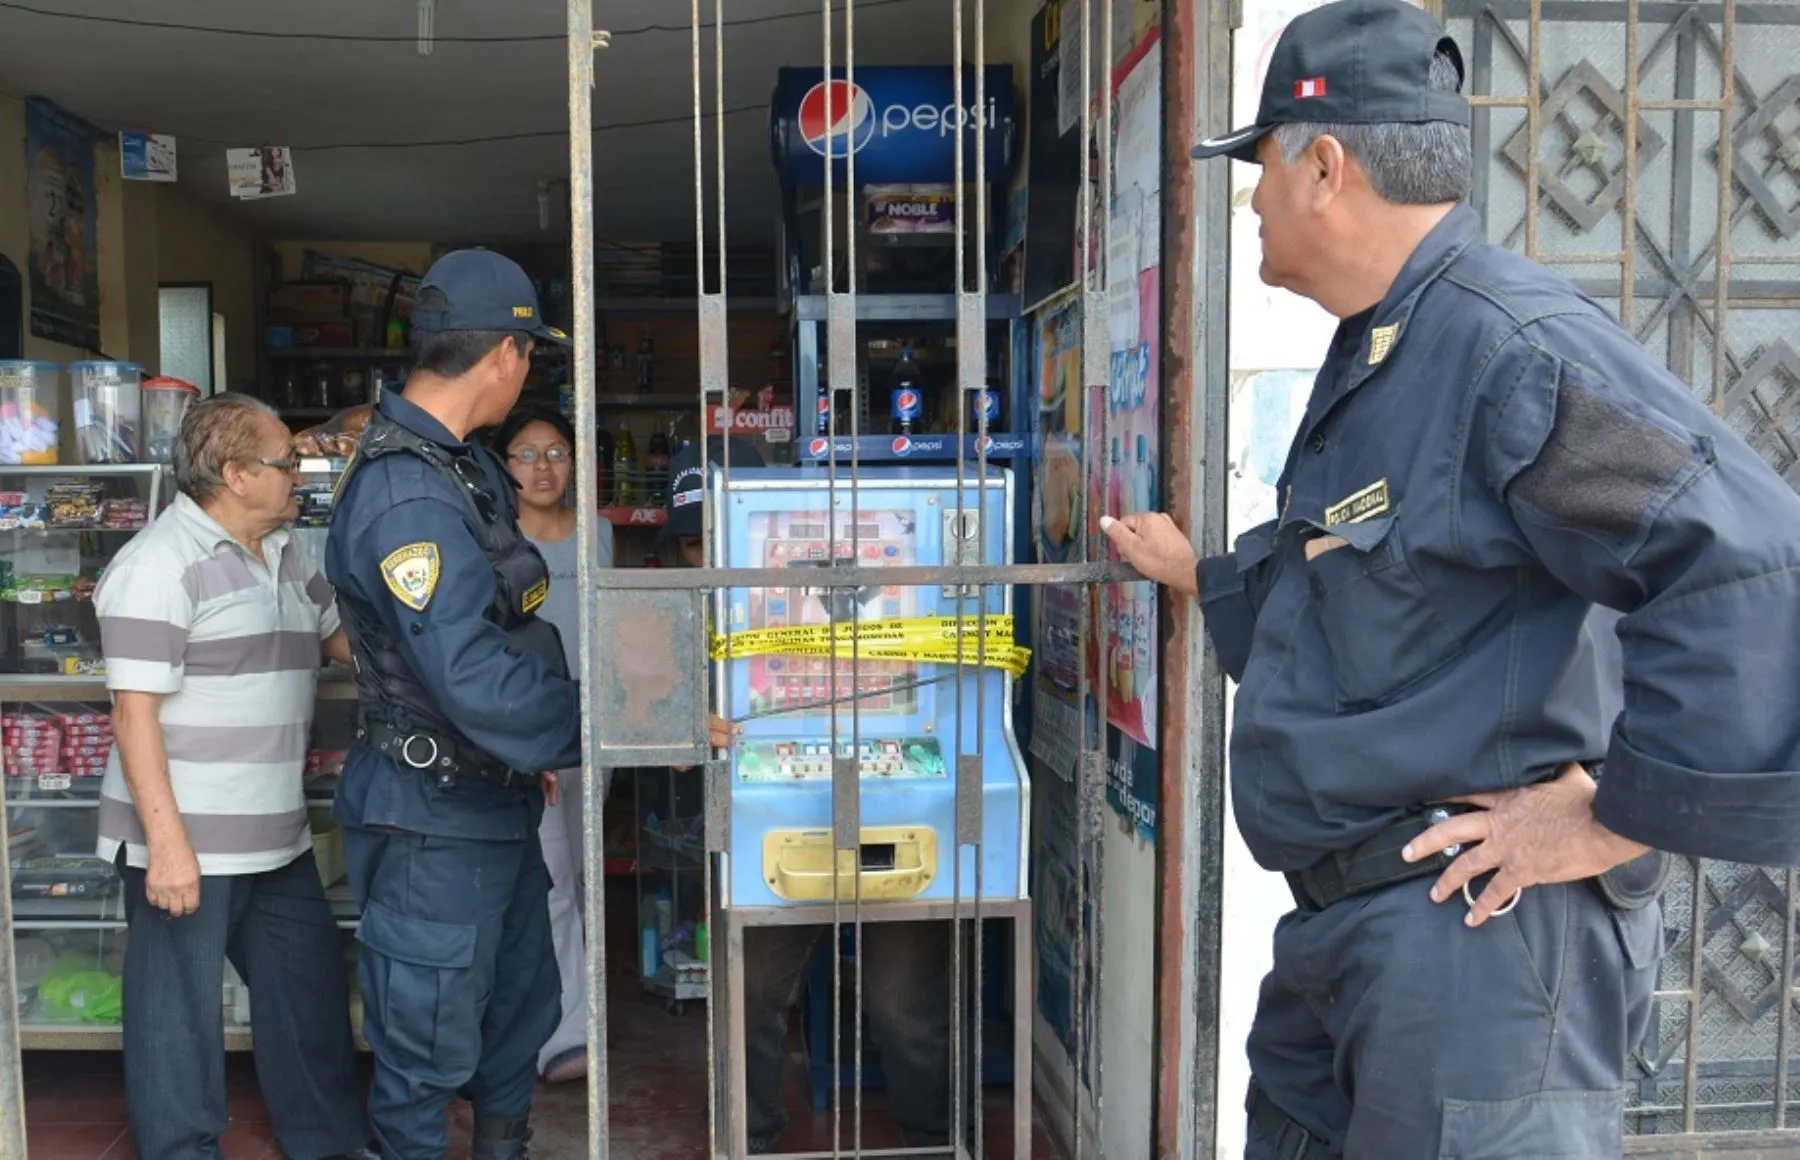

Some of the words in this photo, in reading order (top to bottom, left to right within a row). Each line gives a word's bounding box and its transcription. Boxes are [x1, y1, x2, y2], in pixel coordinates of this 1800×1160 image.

[882, 97, 996, 138] pepsi
[909, 440, 942, 452] pepsi
[767, 628, 816, 639] GENERAL
